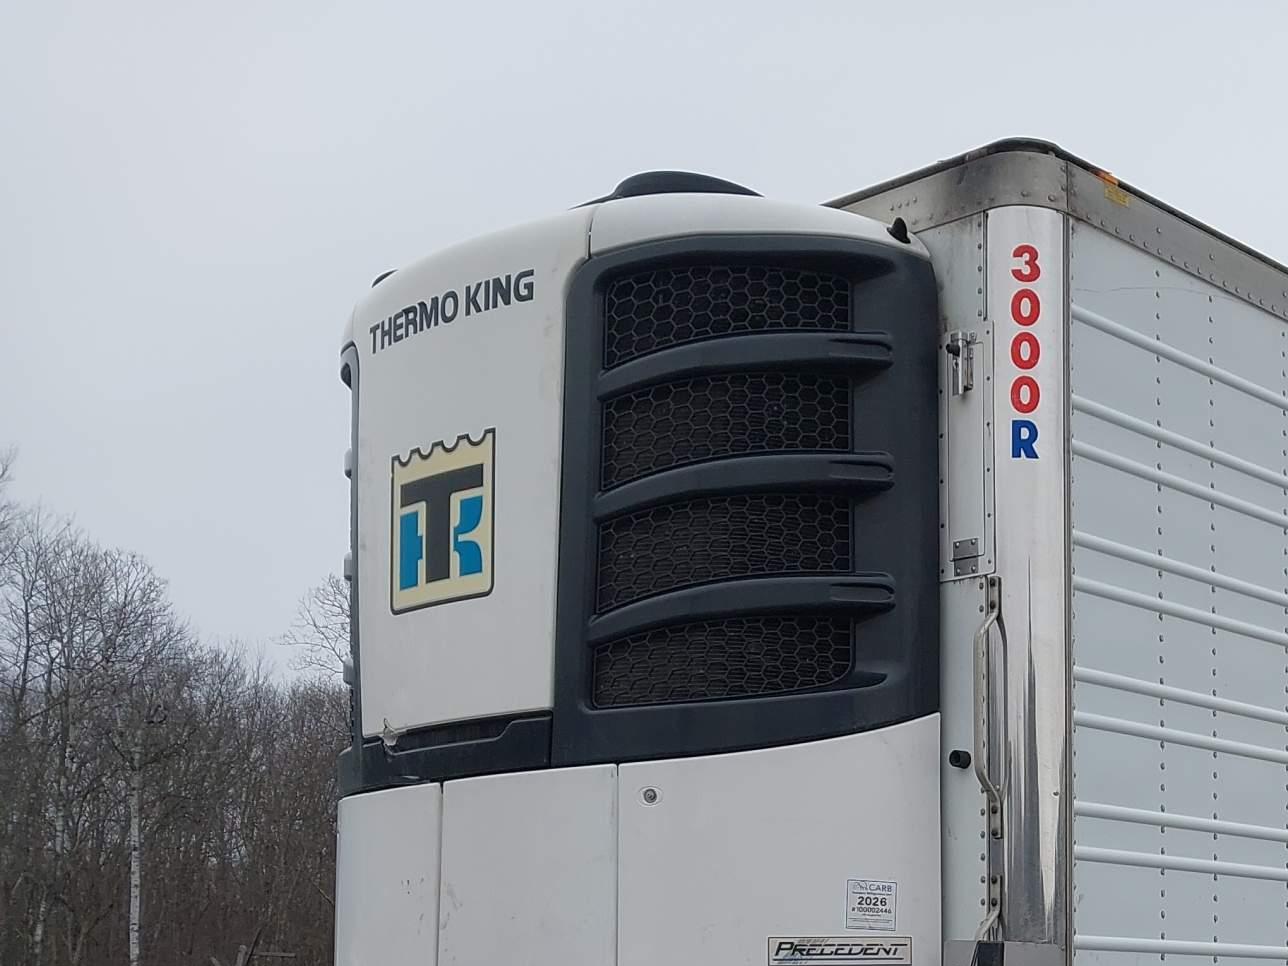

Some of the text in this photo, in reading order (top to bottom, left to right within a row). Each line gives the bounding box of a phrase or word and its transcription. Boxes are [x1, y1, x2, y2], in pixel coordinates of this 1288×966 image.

[369, 269, 535, 355] THERMO KING
[1011, 244, 1041, 460] 3000R
[868, 884, 893, 893] CARB
[857, 896, 887, 907] 2026
[774, 941, 908, 957] PRECEDENT
